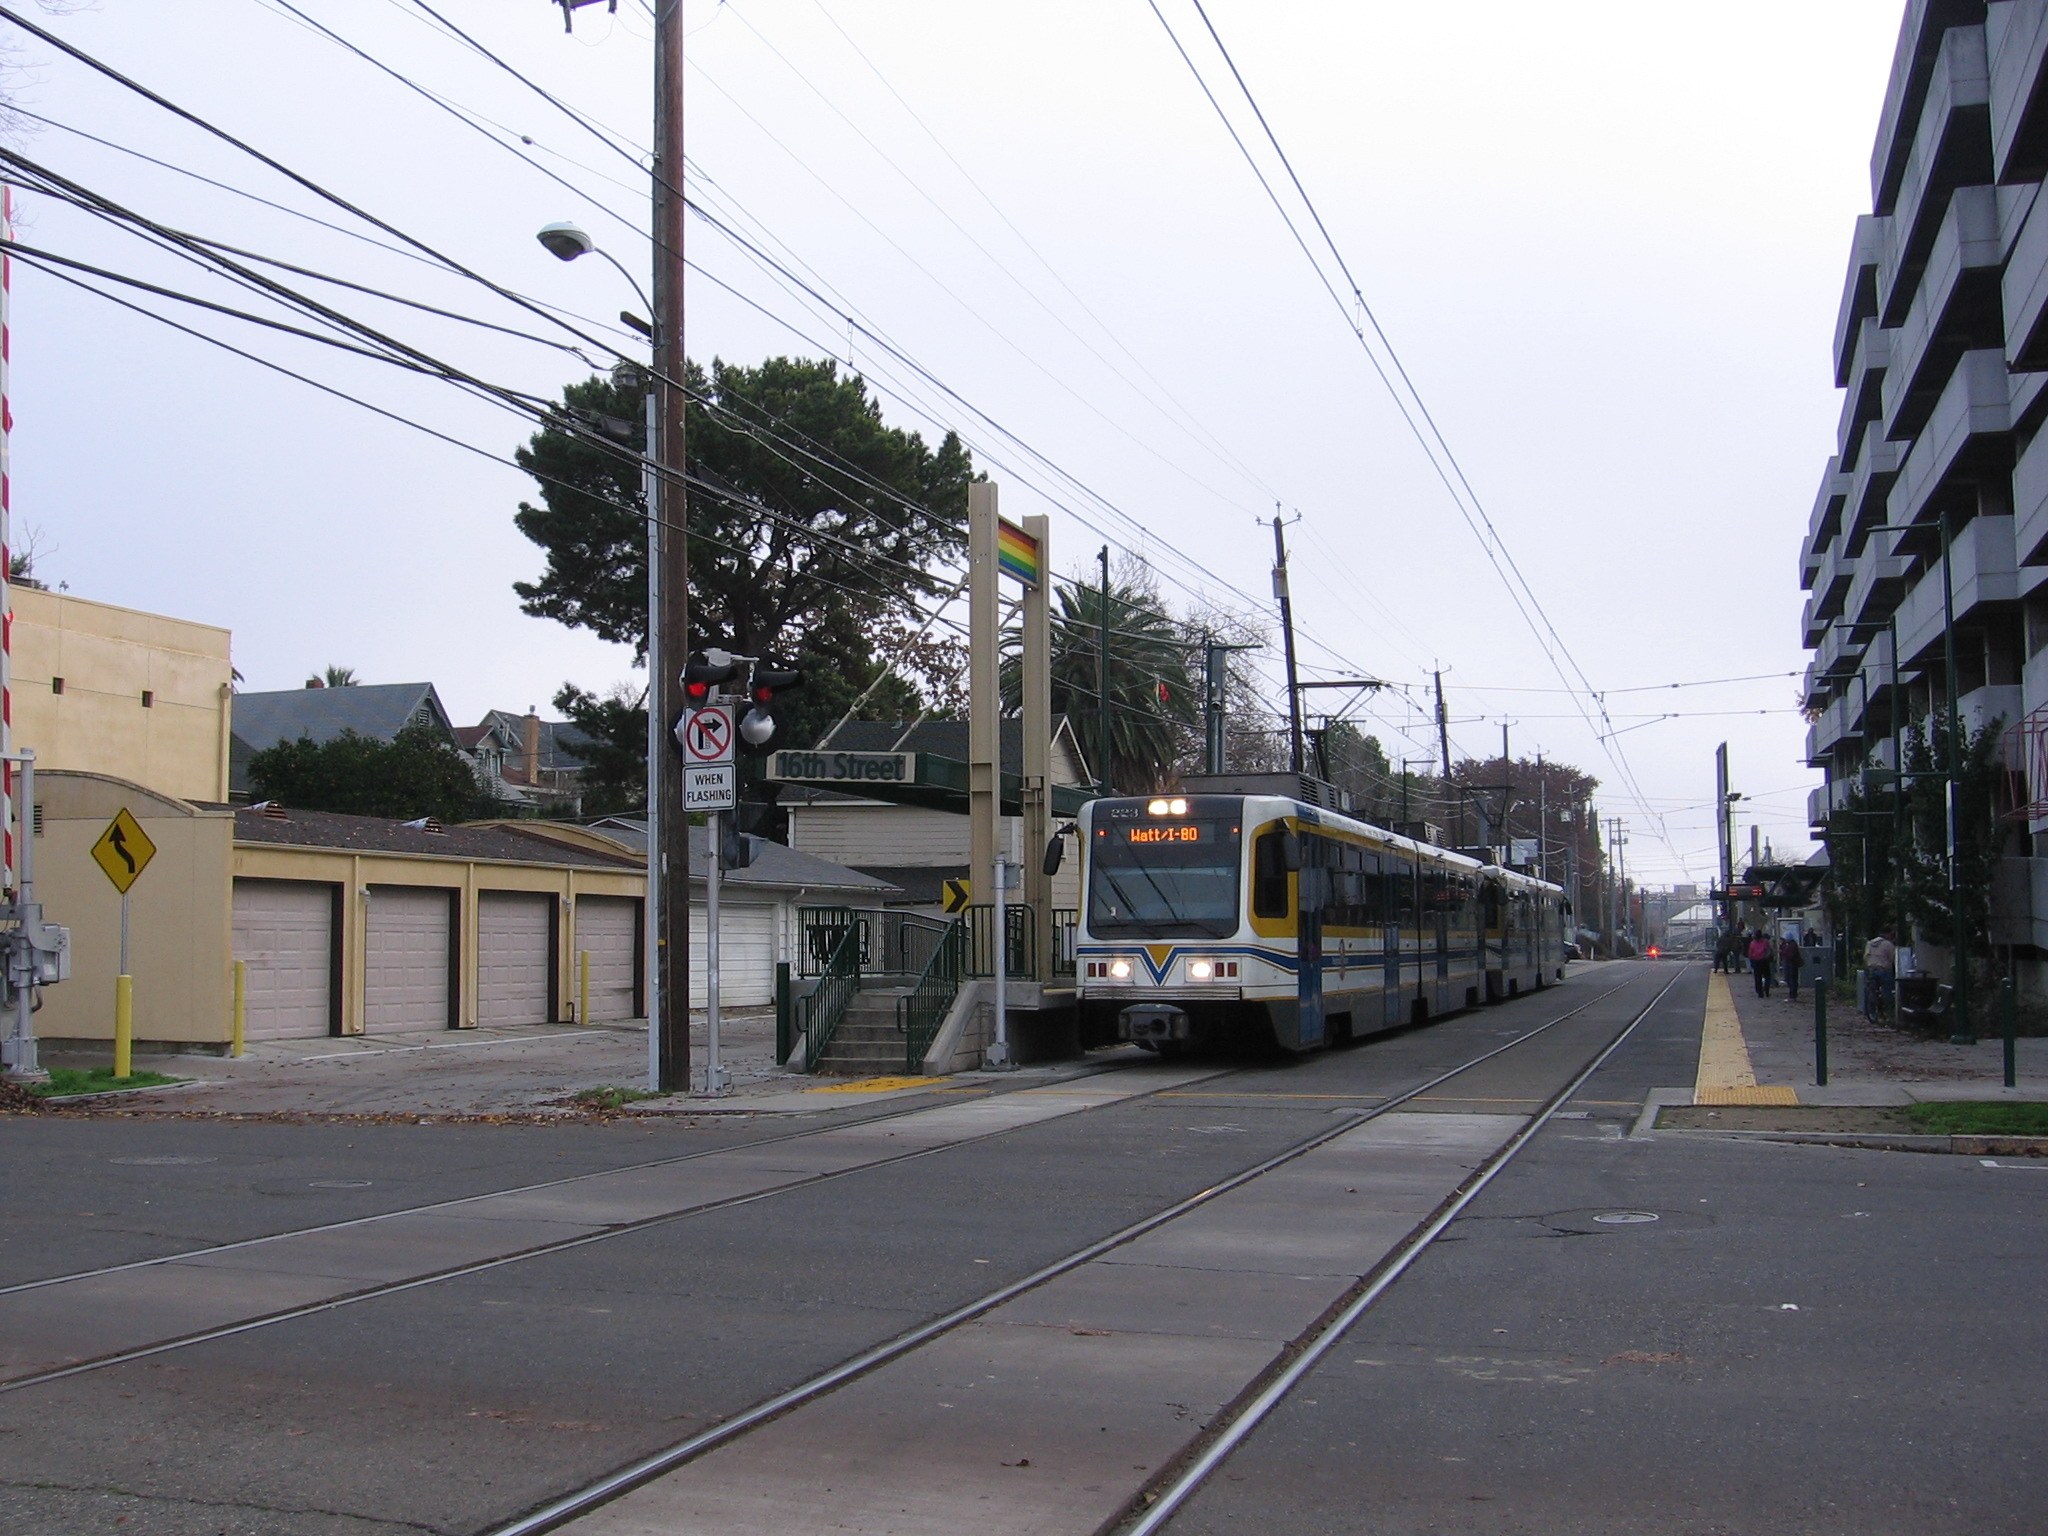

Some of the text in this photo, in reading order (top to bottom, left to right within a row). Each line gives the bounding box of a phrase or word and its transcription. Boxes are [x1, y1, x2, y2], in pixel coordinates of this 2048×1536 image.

[779, 752, 904, 780] 16th Street
[695, 774, 723, 786] WHEN
[687, 789, 732, 802] FLASHING
[1131, 827, 1197, 842] Watt/I-80
